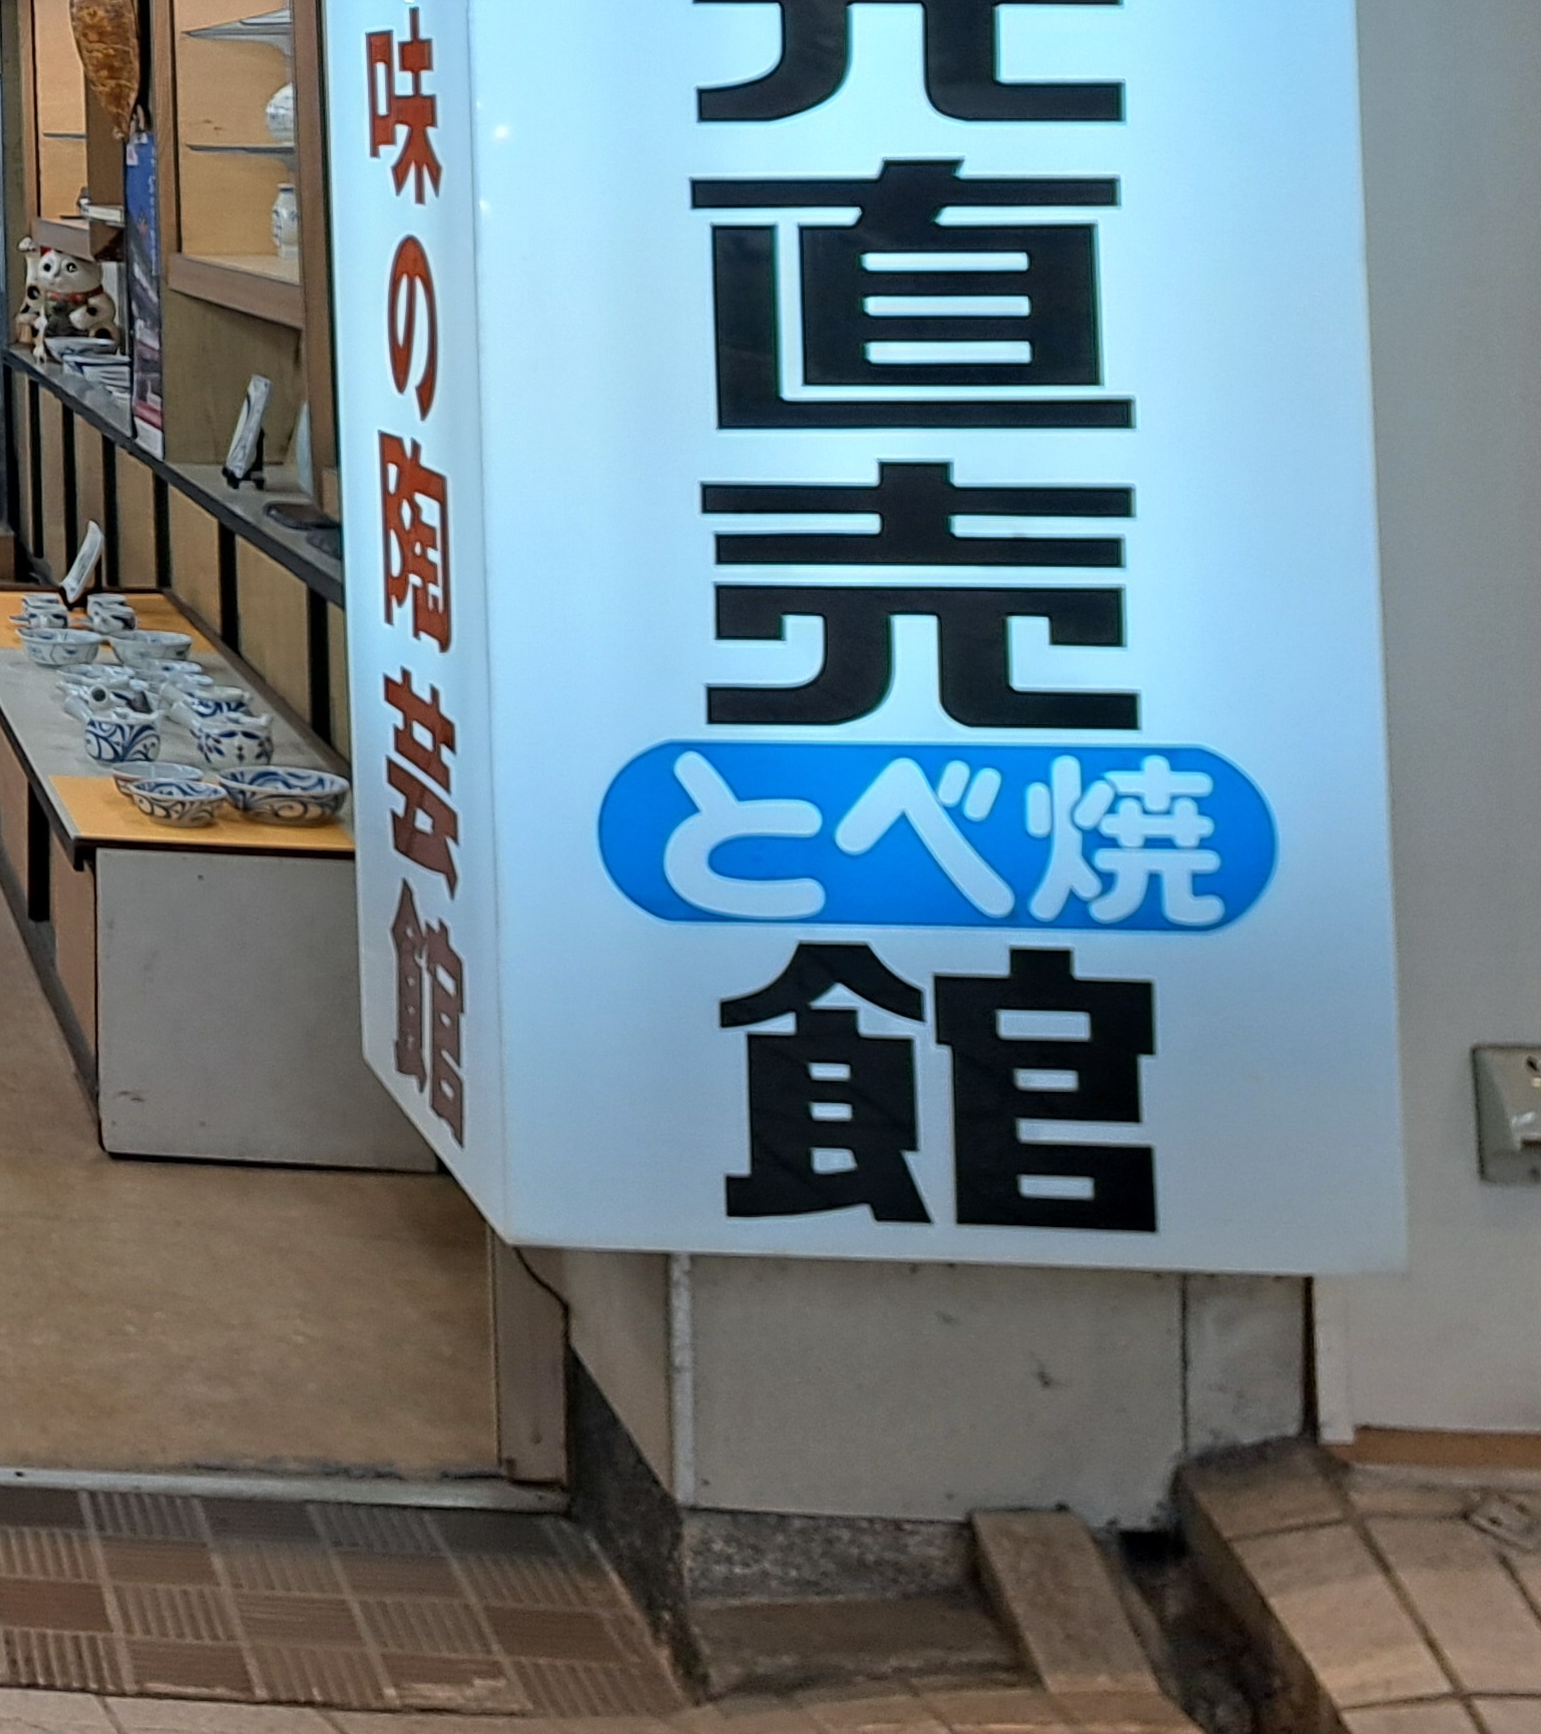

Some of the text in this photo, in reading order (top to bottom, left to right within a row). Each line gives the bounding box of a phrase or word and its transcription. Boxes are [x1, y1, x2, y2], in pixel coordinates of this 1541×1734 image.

[663, 750, 1223, 926] とべ焼
[719, 941, 1157, 1233] 館
